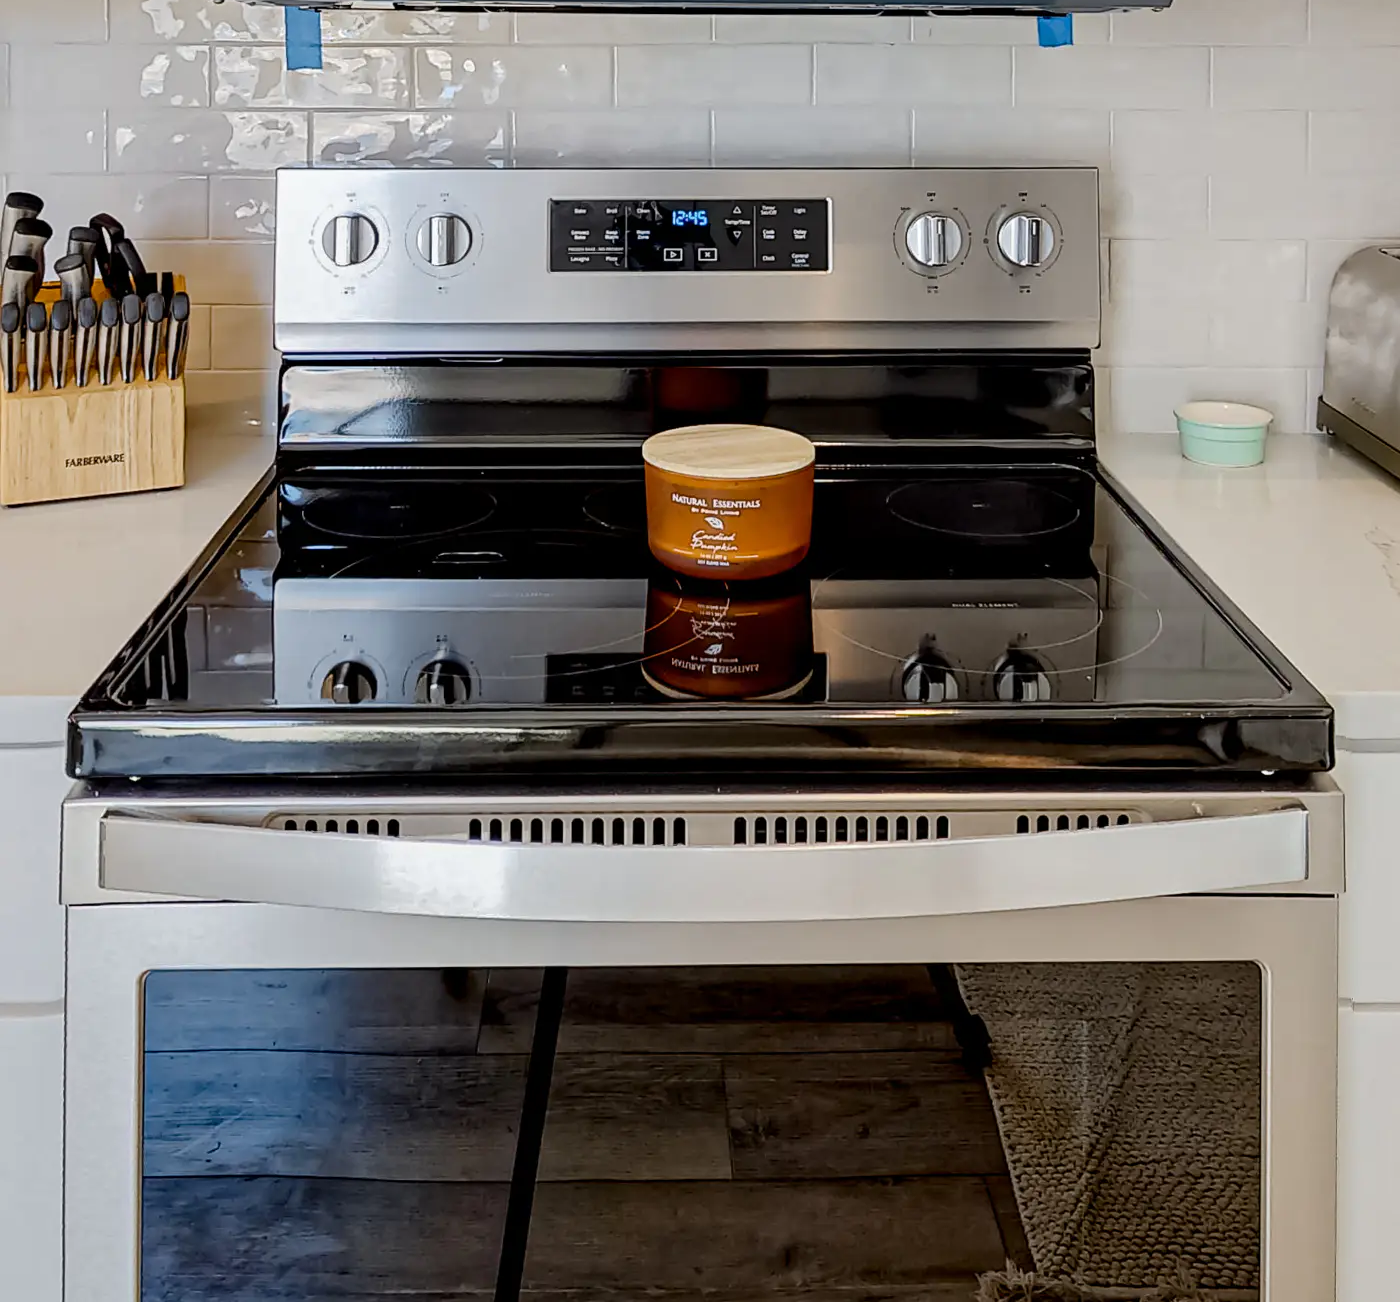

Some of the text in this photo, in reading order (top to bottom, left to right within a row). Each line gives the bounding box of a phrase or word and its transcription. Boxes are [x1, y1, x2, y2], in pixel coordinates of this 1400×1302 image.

[672, 210, 708, 226] 12:45
[65, 453, 125, 468] FARBERWARE
[672, 493, 760, 508] NATURAL ESSENTIALS
